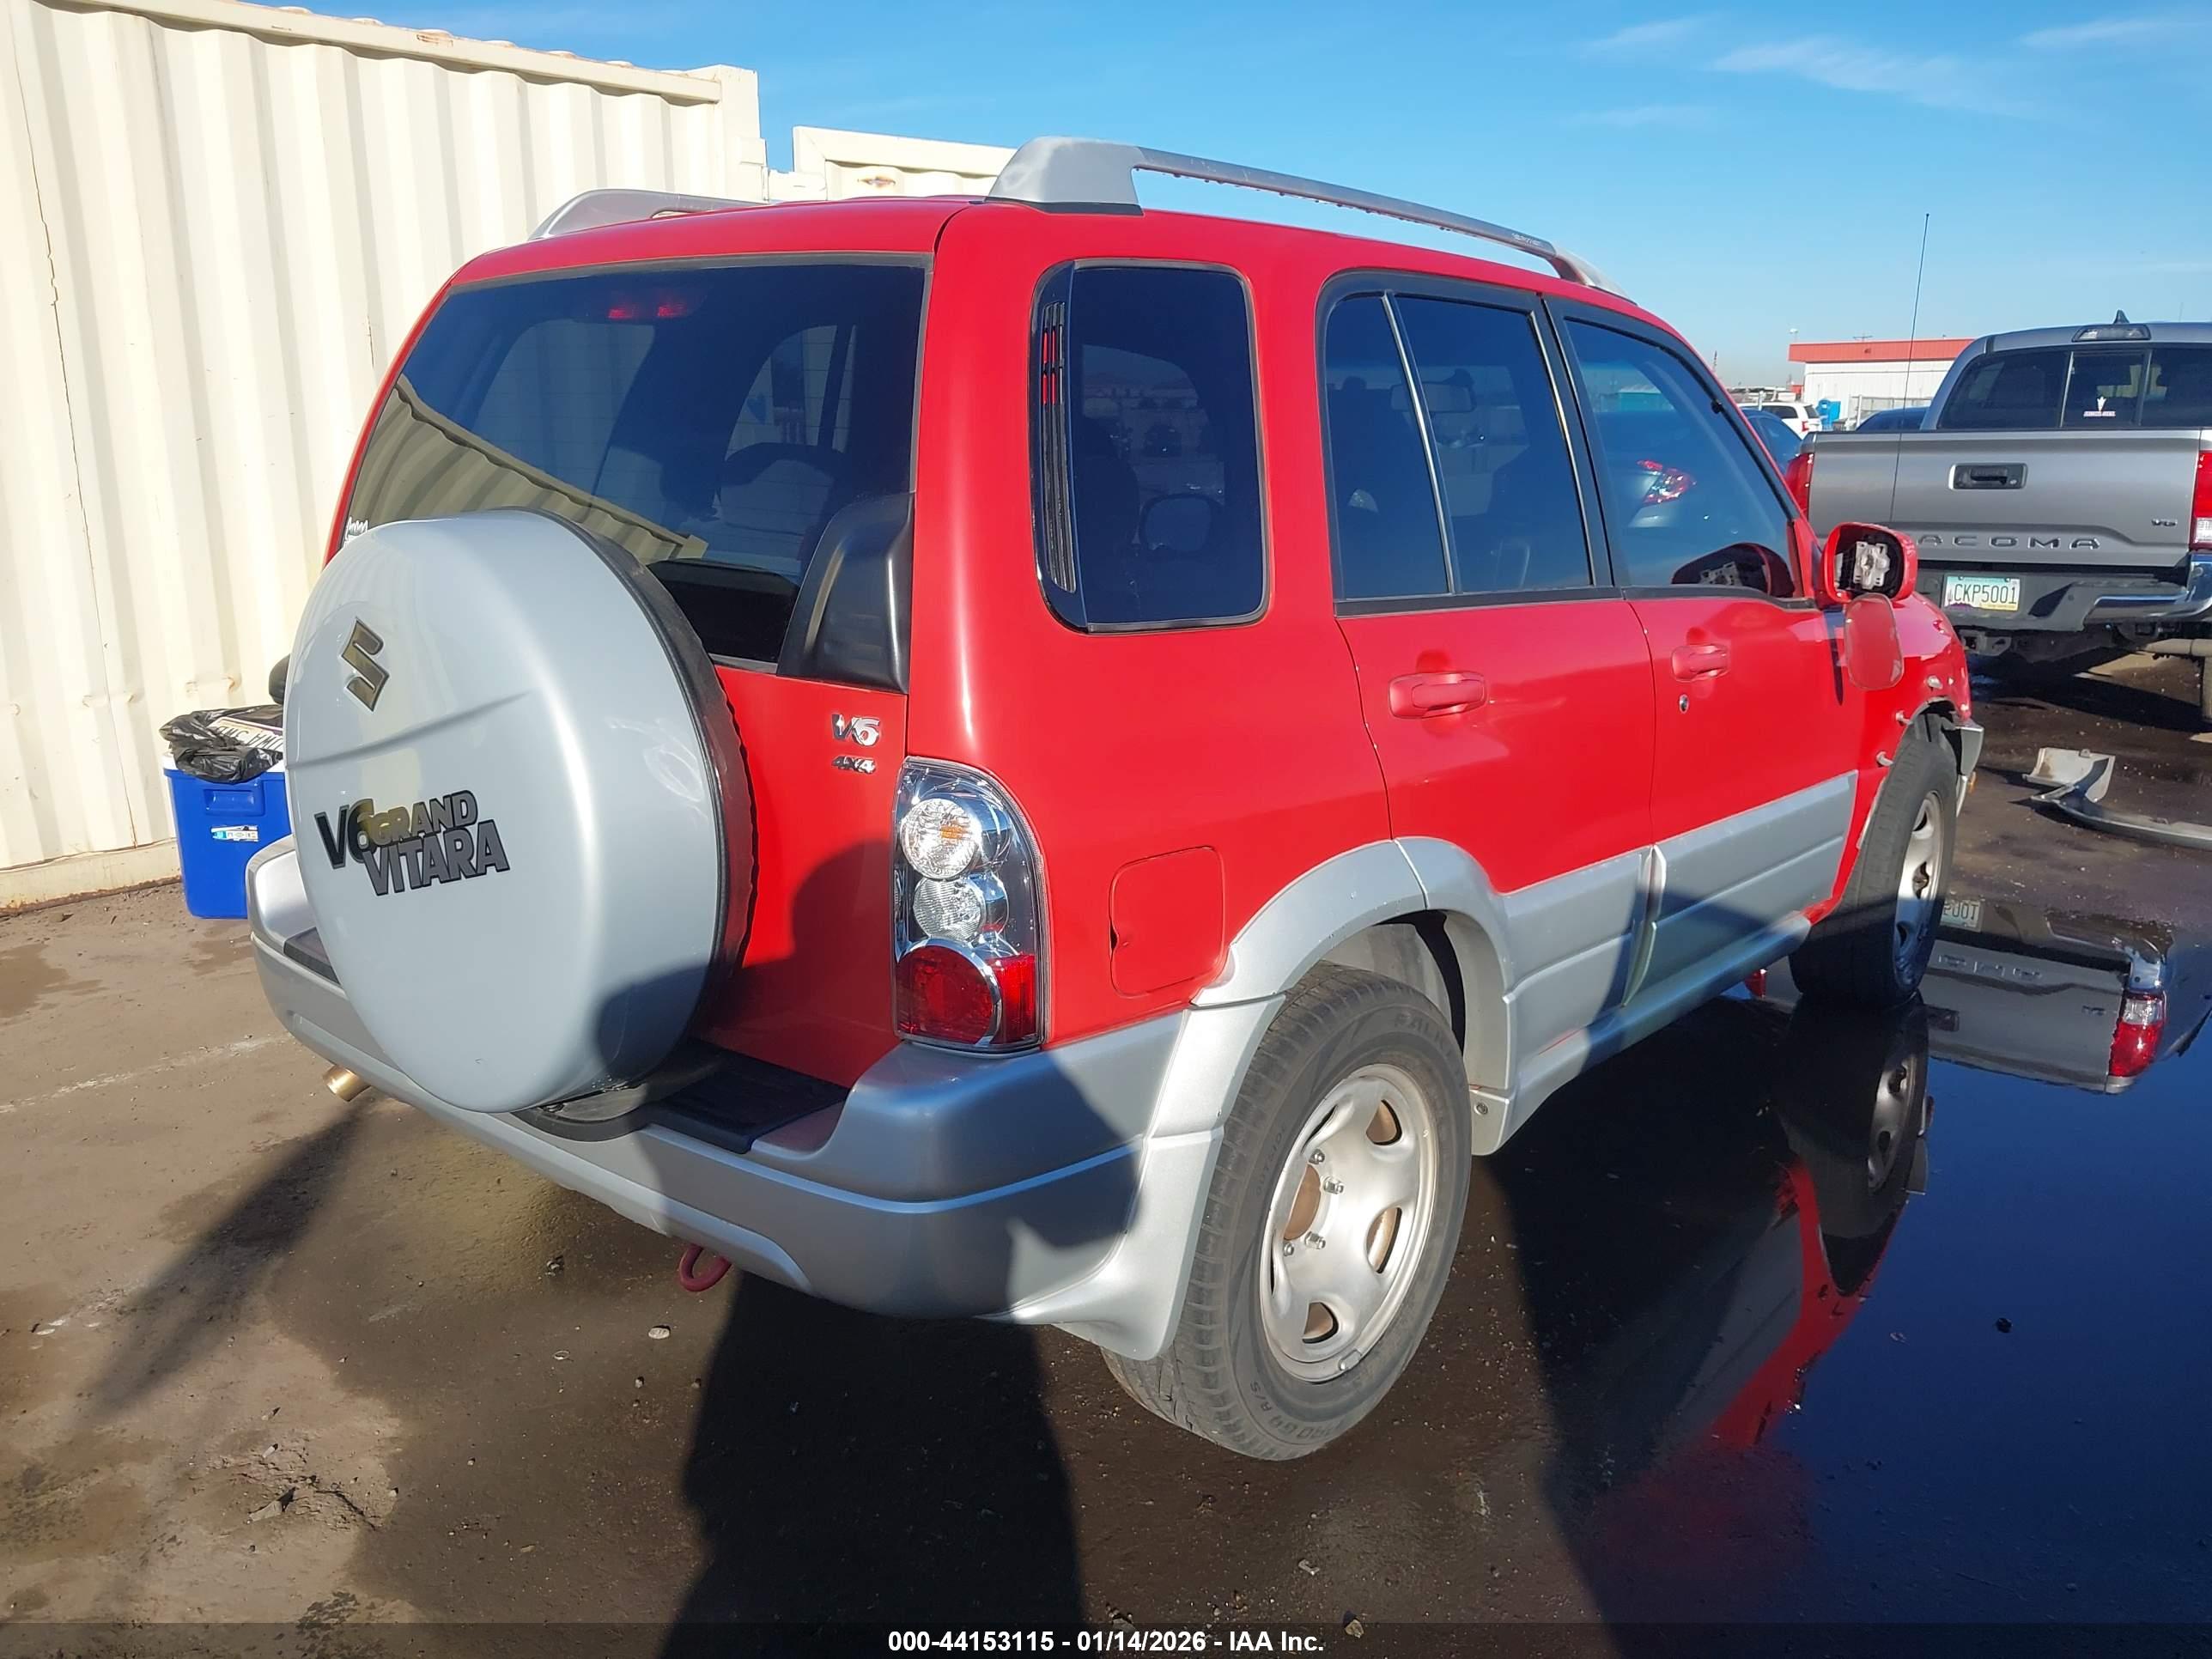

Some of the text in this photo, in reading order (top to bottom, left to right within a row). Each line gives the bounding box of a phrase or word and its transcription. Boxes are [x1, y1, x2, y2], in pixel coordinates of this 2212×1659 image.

[1954, 584, 2016, 605] CKP5001
[831, 714, 880, 746] V6
[313, 789, 478, 870] V6 GRAND
[361, 818, 511, 896] VITARA
